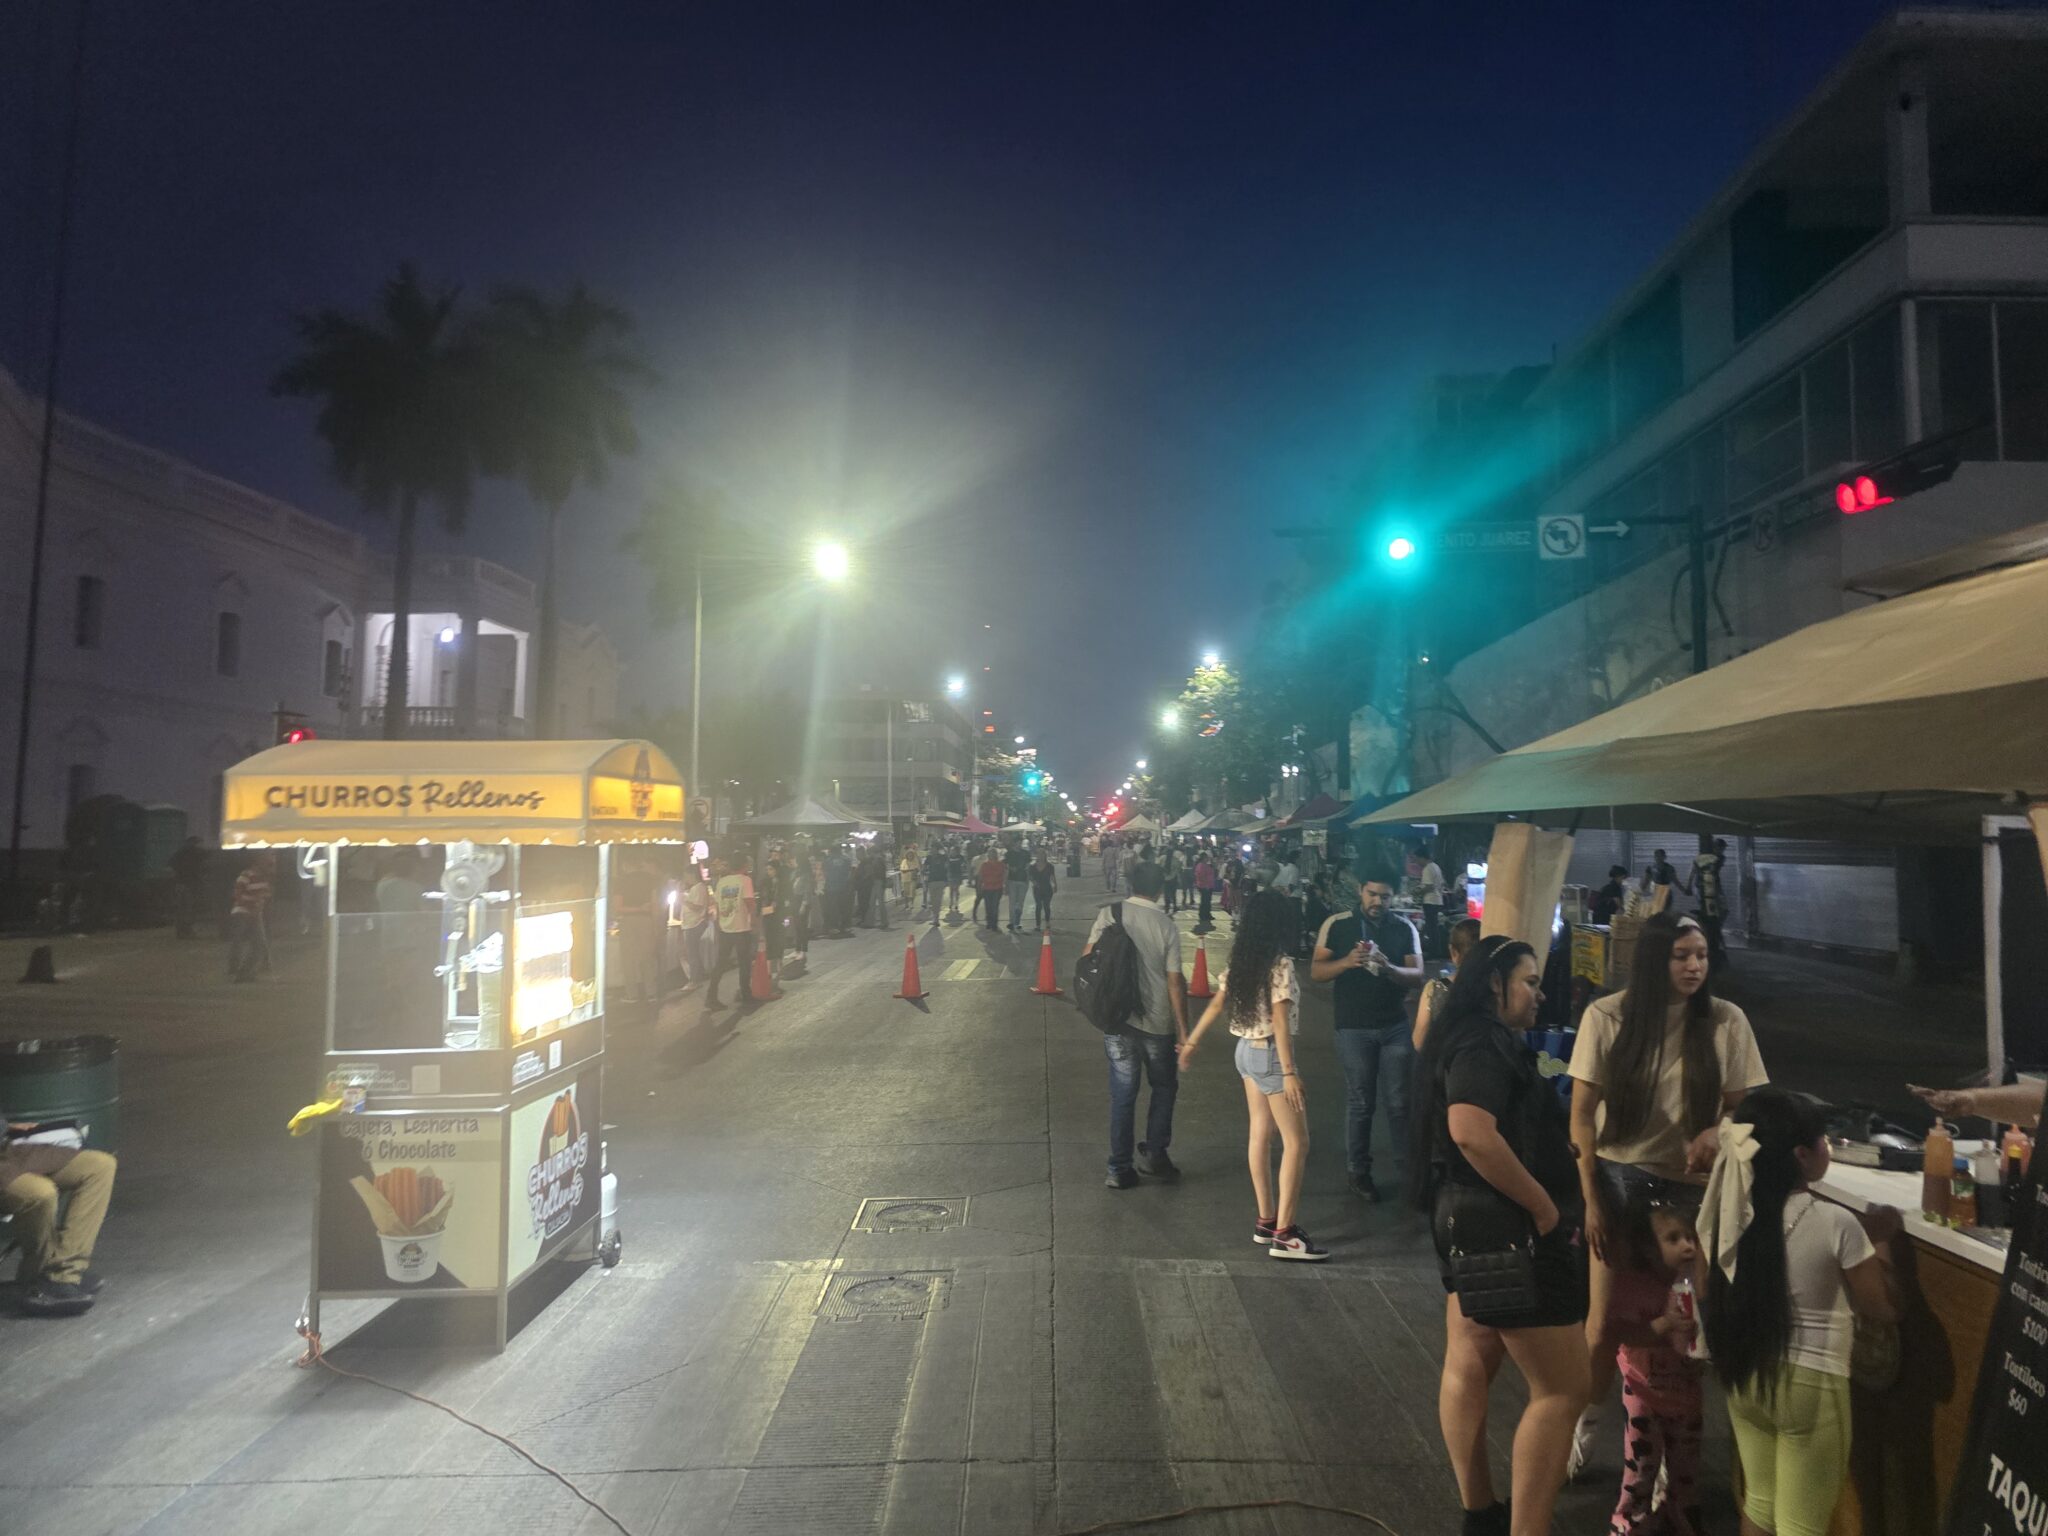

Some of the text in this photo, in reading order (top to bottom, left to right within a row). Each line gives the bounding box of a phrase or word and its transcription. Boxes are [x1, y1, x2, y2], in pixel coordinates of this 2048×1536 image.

[265, 780, 546, 813] CHURROS Rellenos
[378, 1139, 457, 1160] Chocolate
[529, 1132, 588, 1196] CHURROS
[2022, 1316, 2048, 1346] $100
[2004, 1351, 2046, 1398] Tostiloco
[2008, 1388, 2028, 1416] $60
